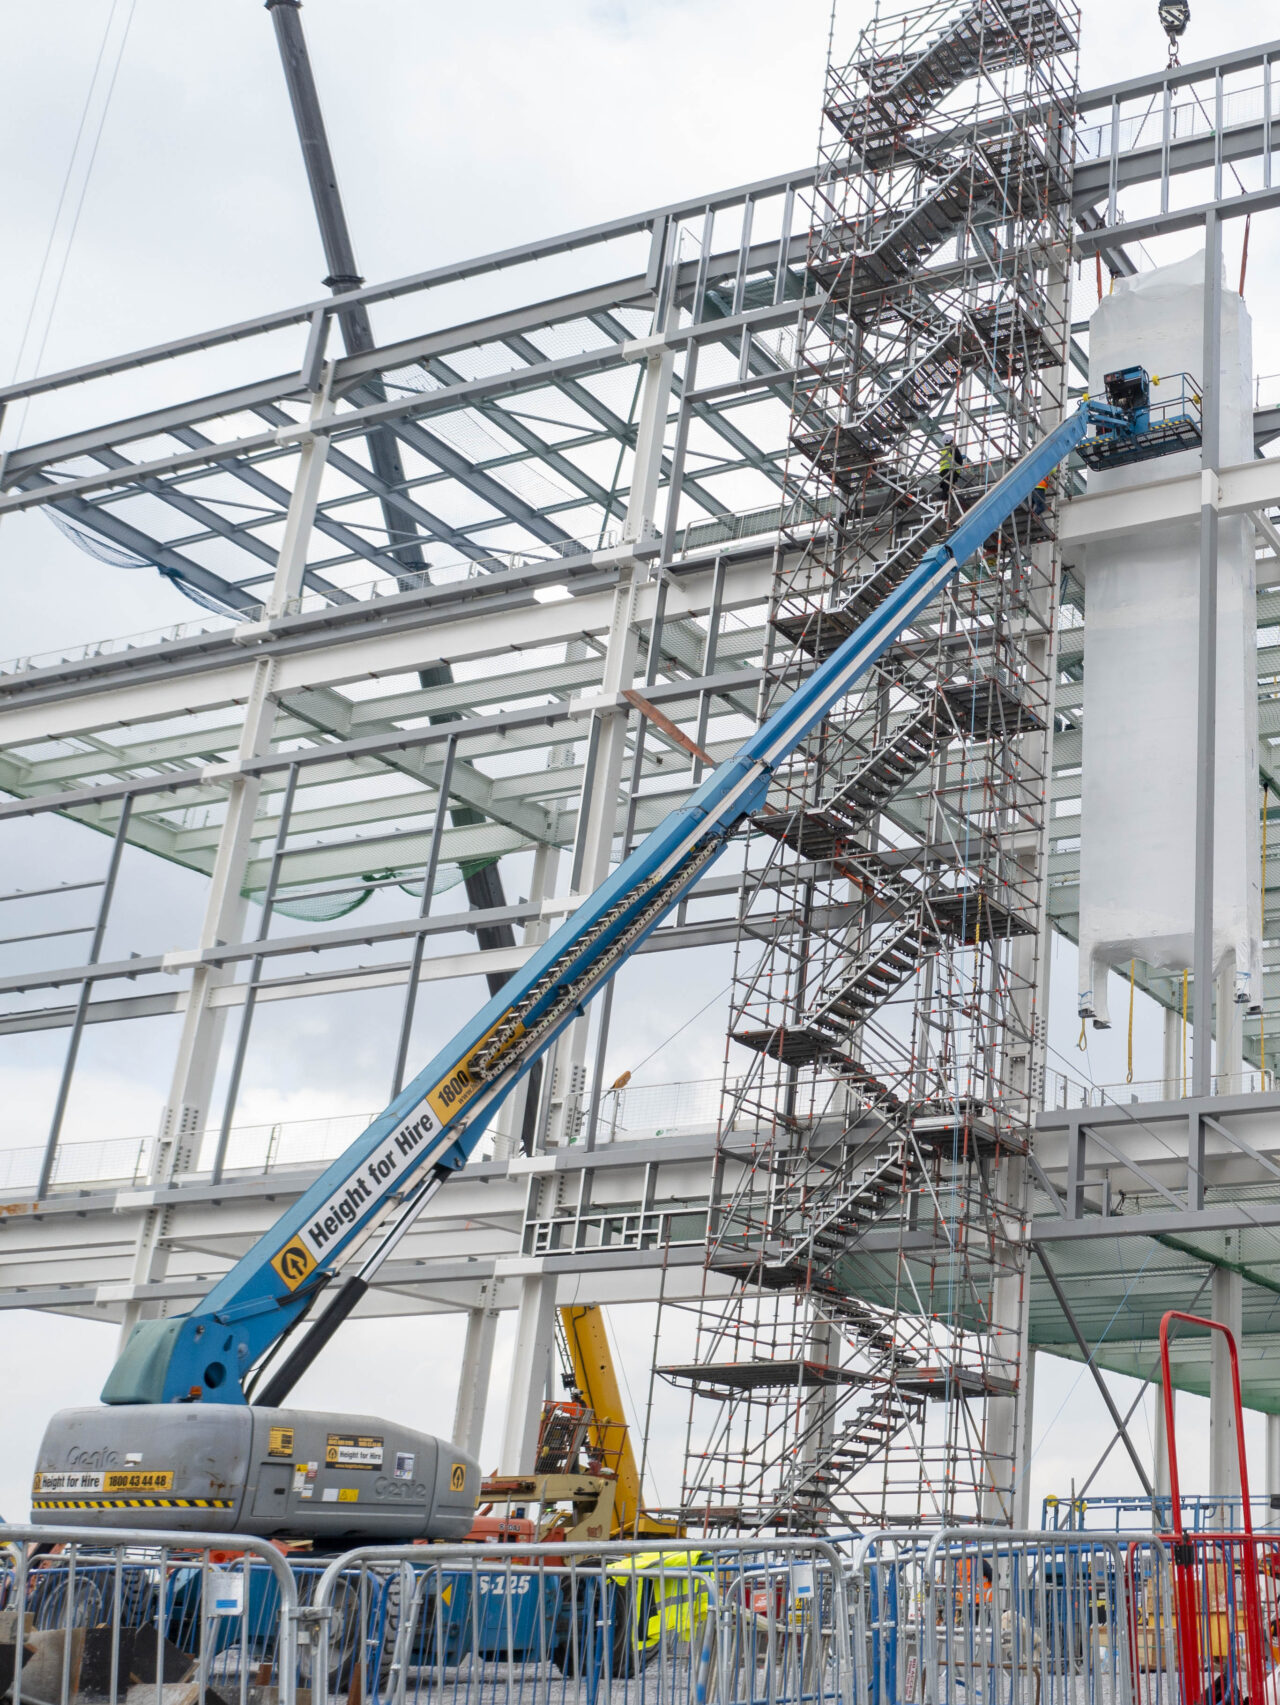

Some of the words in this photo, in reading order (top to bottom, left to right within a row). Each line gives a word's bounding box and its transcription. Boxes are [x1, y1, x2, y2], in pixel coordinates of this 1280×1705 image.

[438, 1069, 469, 1108] 1800
[308, 1177, 372, 1249] Height
[367, 1150, 397, 1185] for
[394, 1114, 434, 1157] Hire
[42, 1476, 65, 1490] Height
[67, 1475, 79, 1488] for
[81, 1475, 100, 1488] Hire
[109, 1476, 128, 1487] 1800
[129, 1475, 140, 1486] 43
[154, 1475, 166, 1486] 48
[375, 1476, 426, 1499] Genie
[479, 1575, 532, 1595] S-125
